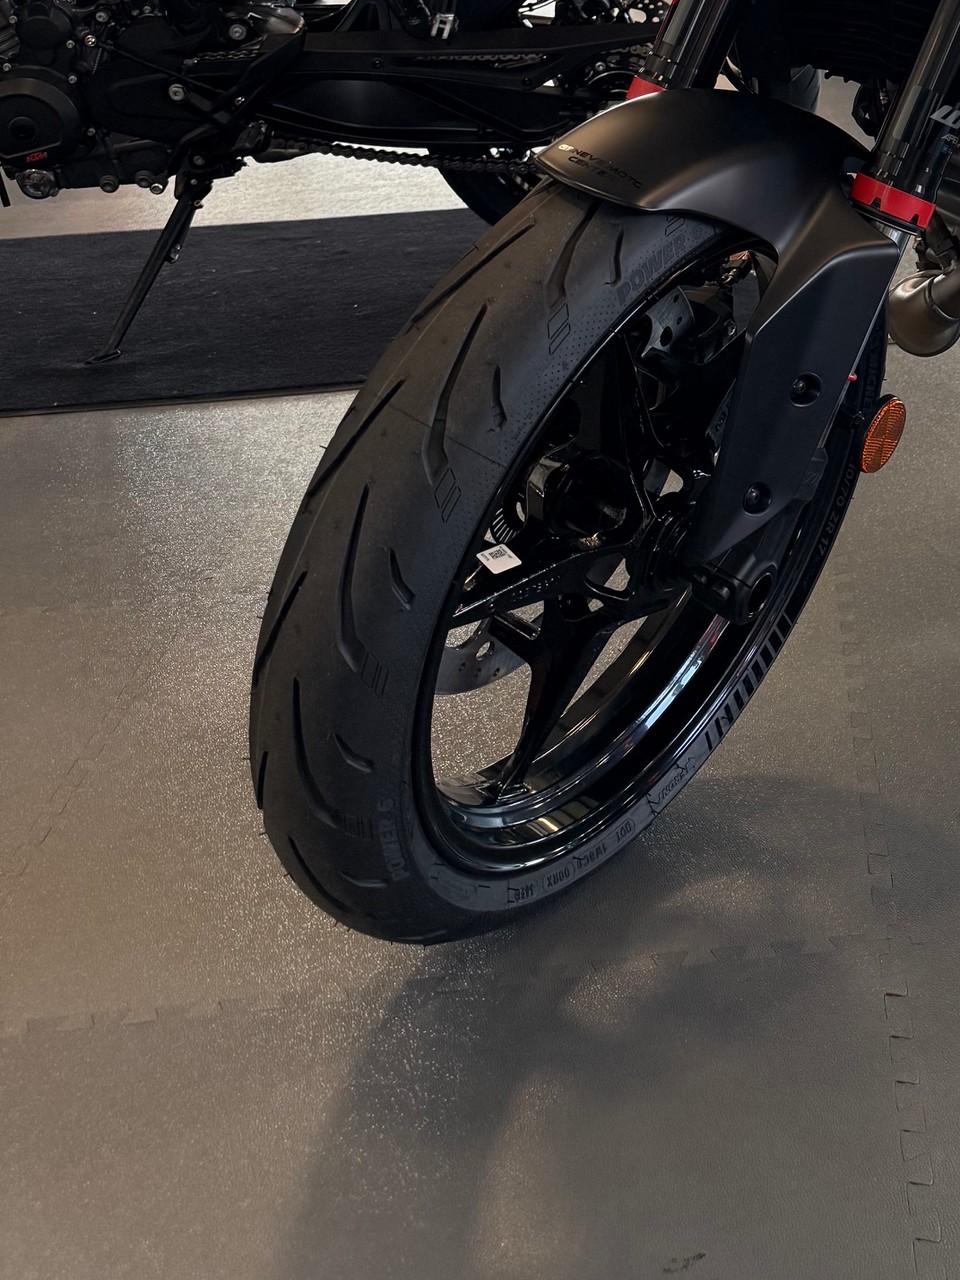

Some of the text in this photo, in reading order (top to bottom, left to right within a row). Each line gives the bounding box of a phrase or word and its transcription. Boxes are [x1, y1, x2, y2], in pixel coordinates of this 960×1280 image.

[616, 233, 686, 301] POWER
[825, 509, 841, 539] ZR
[817, 540, 830, 558] 17
